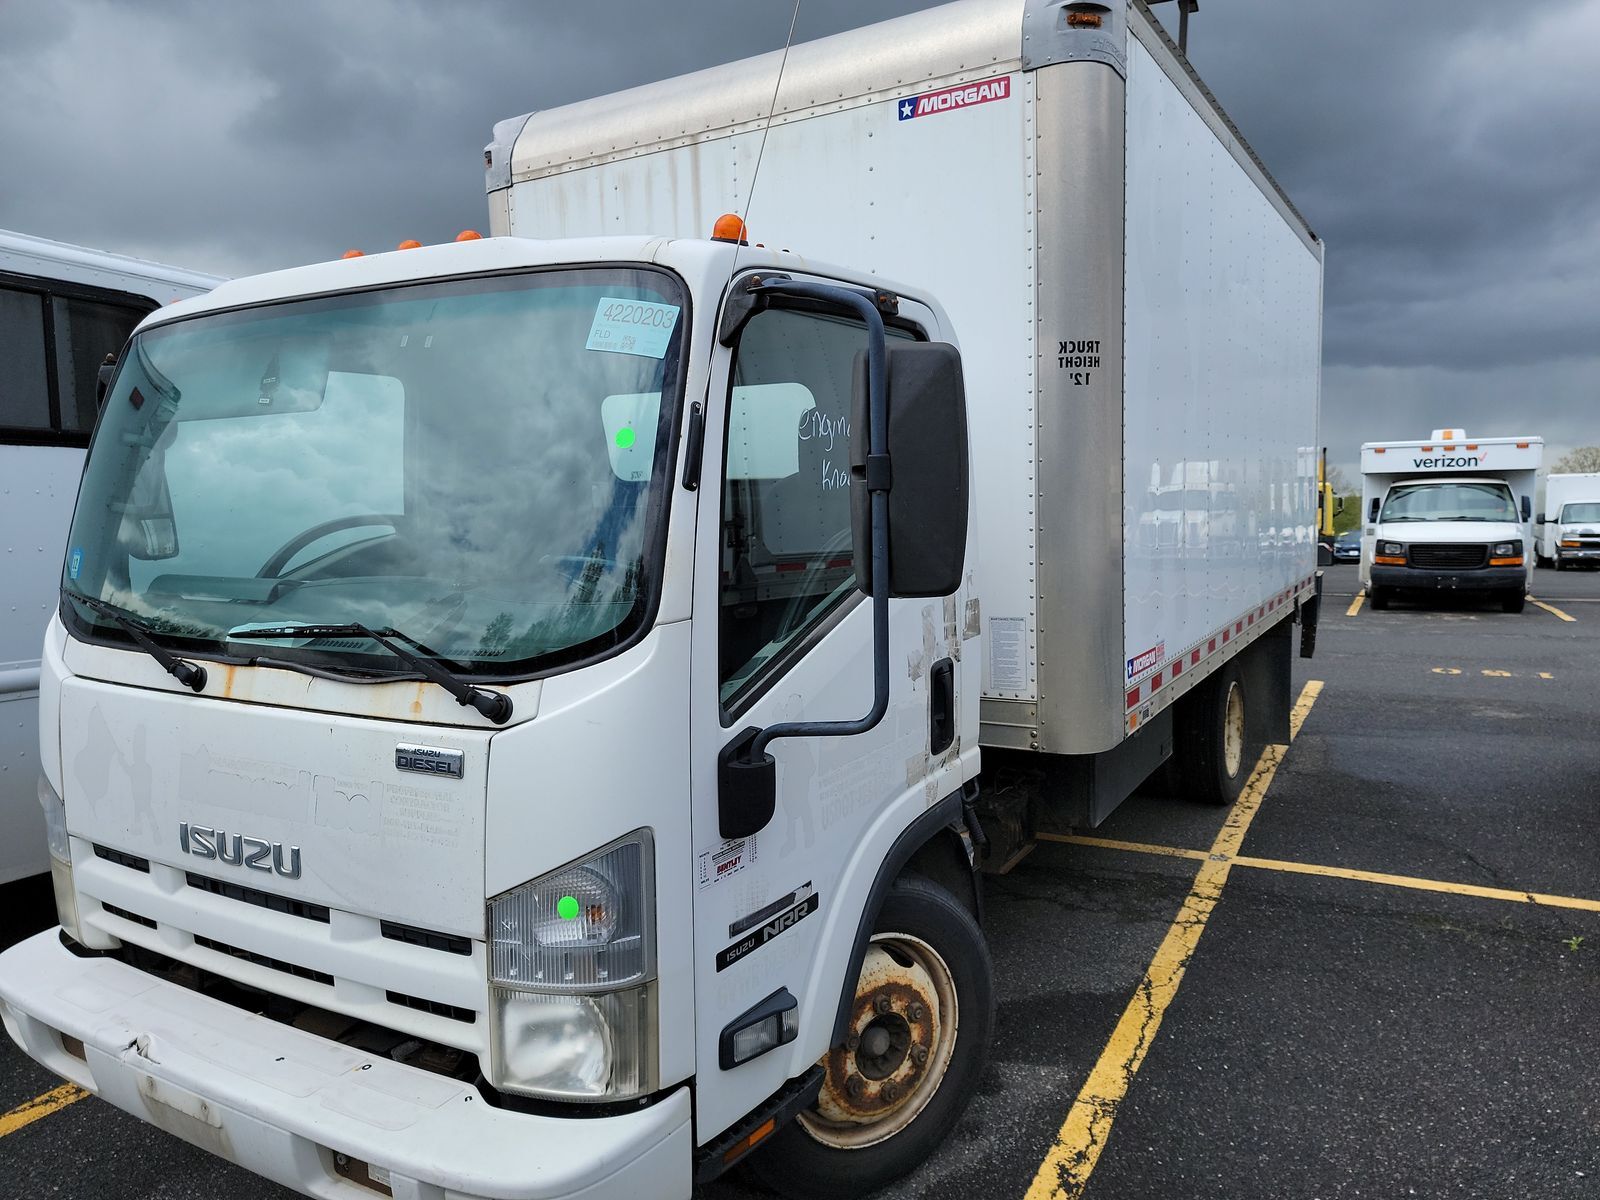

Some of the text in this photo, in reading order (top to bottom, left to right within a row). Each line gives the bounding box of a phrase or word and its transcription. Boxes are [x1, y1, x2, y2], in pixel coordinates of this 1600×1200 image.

[918, 81, 1005, 114] MORGAN
[603, 303, 675, 329] 4220203
[594, 329, 611, 339] FLD
[798, 409, 850, 452] engin
[1413, 454, 1478, 468] verizon
[397, 755, 457, 775] DIESEL
[414, 748, 441, 758] ISUZU
[179, 821, 301, 880] ISUZU
[726, 901, 808, 962] ISUZU NRR
